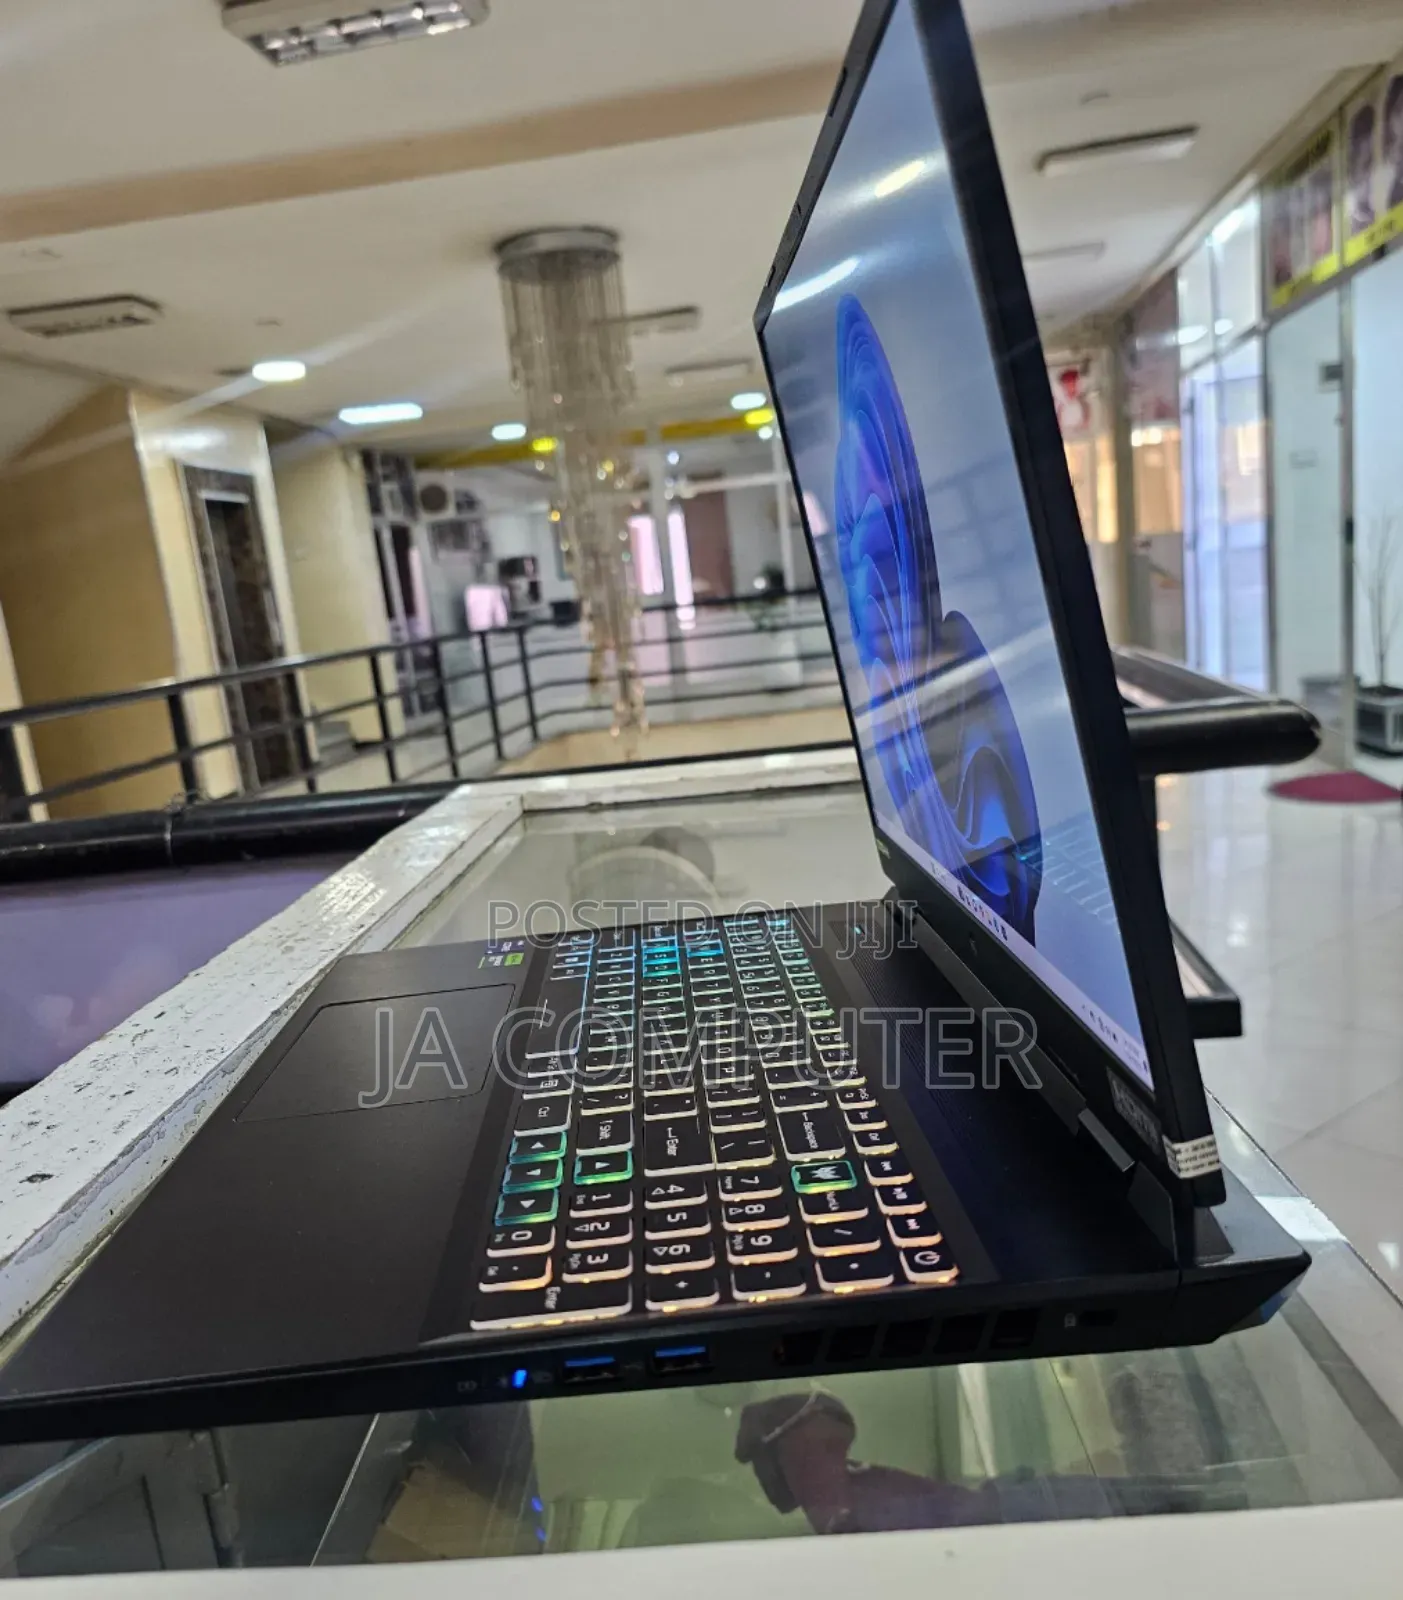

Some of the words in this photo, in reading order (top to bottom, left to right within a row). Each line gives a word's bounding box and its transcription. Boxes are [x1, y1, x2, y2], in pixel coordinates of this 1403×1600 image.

[740, 1175, 760, 1185] 7
[667, 1184, 686, 1194] 4
[591, 1193, 612, 1202] 1
[744, 1203, 766, 1215] 8
[666, 1211, 688, 1223] 5
[589, 1221, 611, 1232] 2
[511, 1229, 533, 1241] 0
[750, 1234, 773, 1247] 9
[668, 1243, 691, 1256] 6
[586, 1253, 609, 1265] 3
